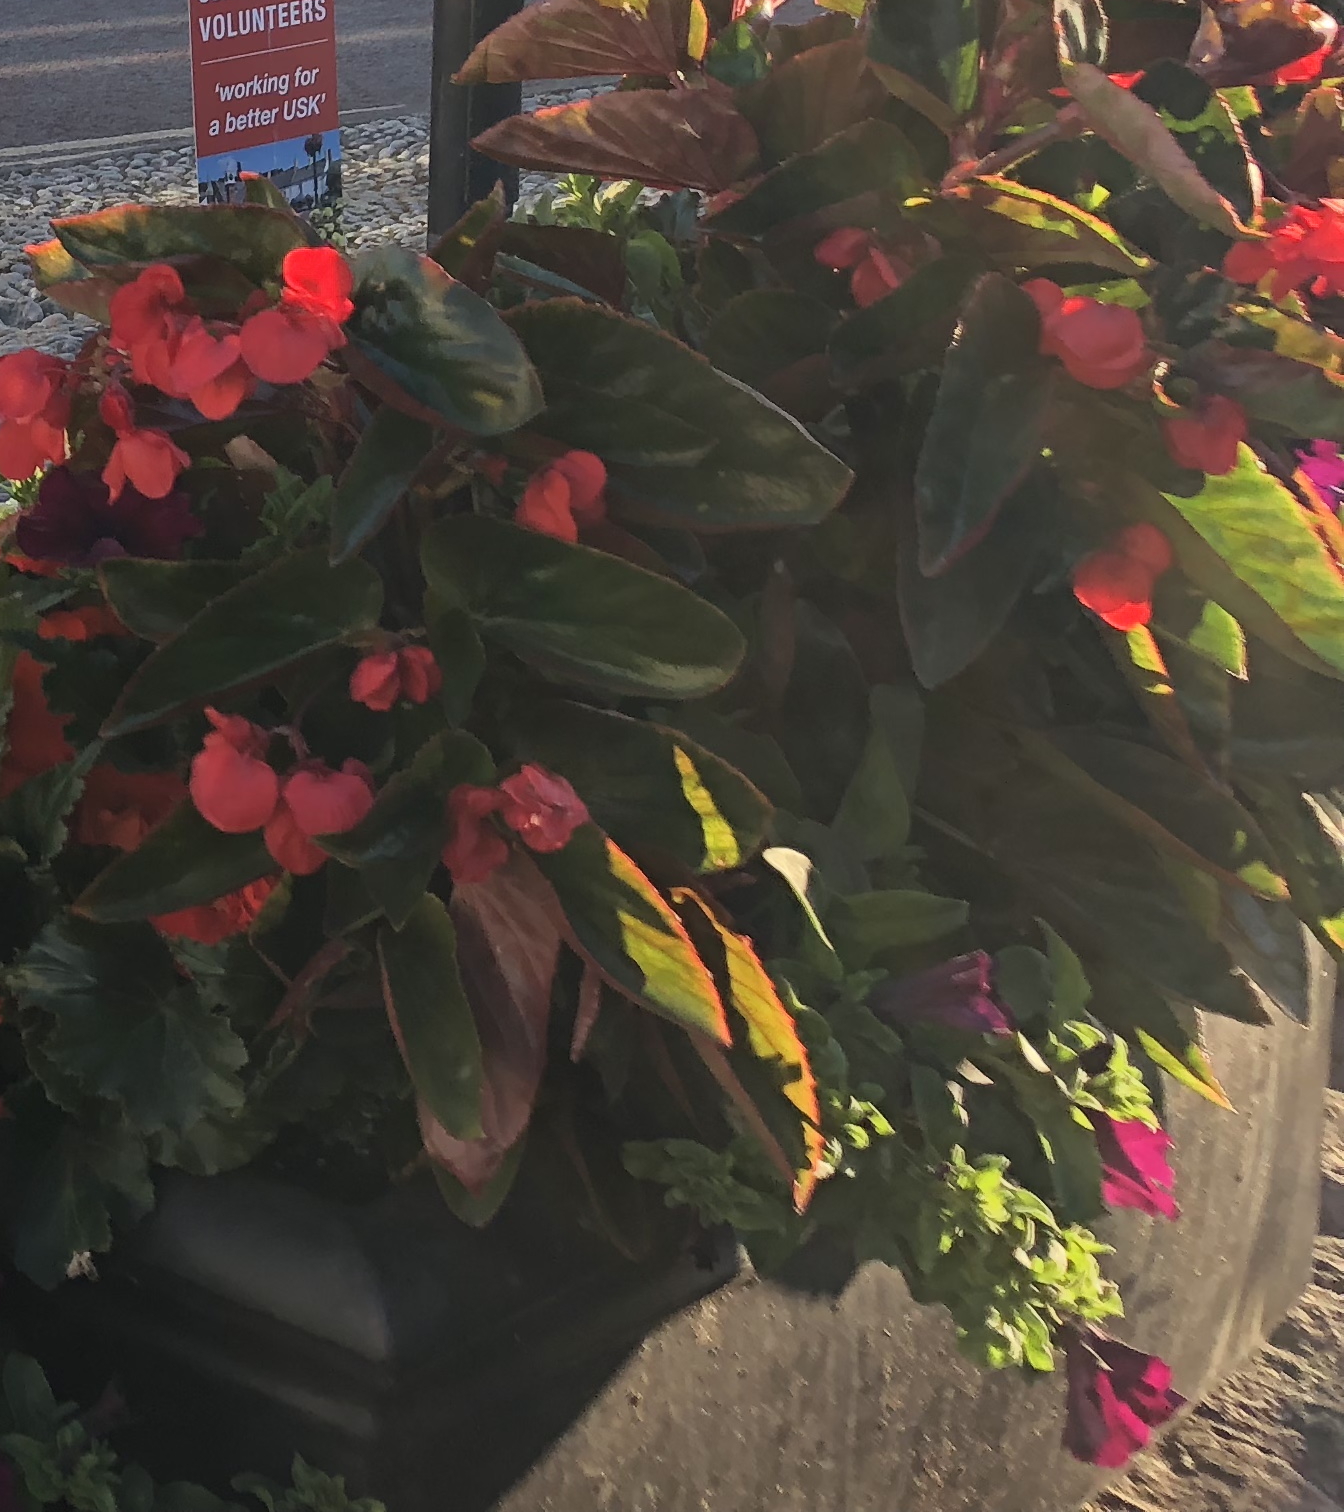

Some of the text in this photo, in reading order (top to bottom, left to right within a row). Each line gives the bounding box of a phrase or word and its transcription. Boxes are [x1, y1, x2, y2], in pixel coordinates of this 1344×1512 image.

[294, 66, 320, 88] for
[209, 120, 220, 137] a
[225, 106, 280, 134] better
